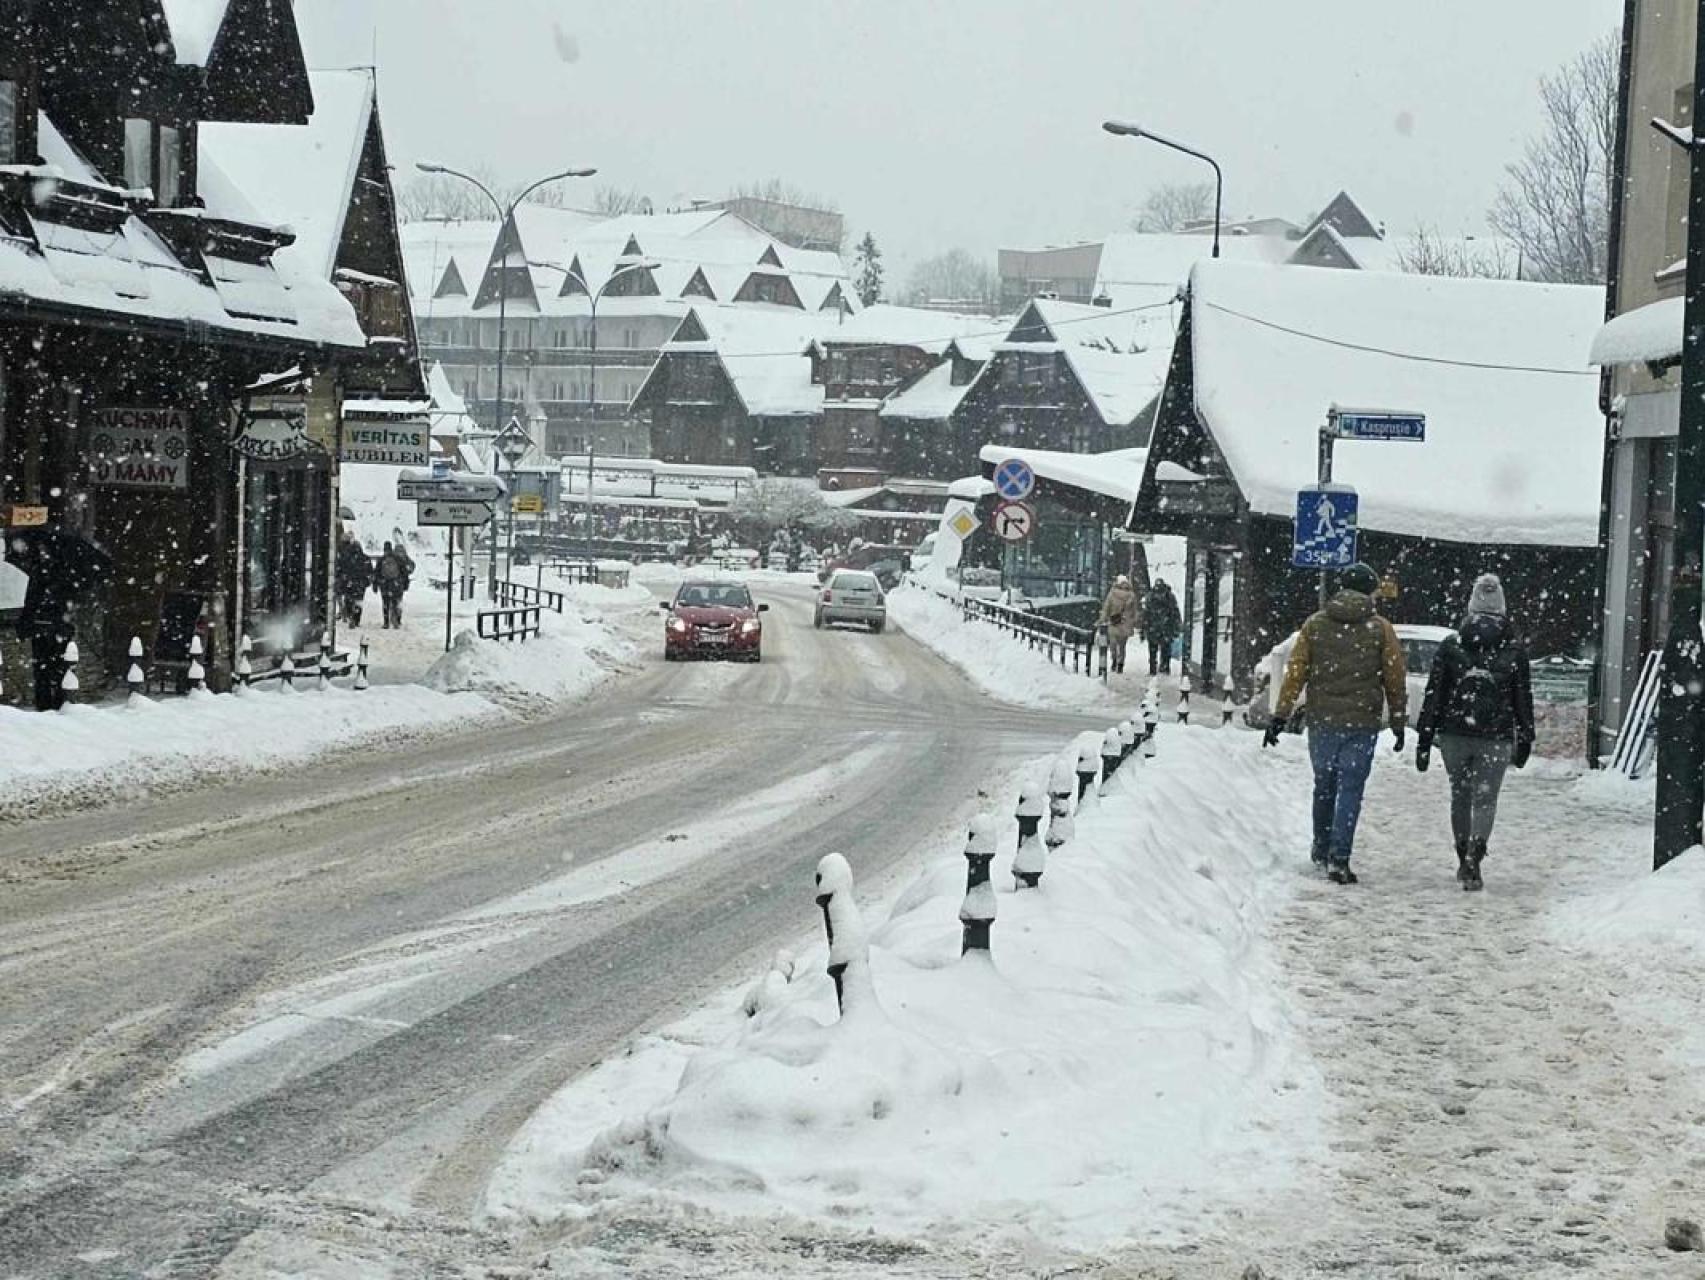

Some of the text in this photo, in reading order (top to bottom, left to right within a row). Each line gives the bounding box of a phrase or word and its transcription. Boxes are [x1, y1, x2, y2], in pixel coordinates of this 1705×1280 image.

[96, 410, 182, 429] KUCHNIA
[1360, 420, 1410, 433] Kasprusie
[344, 449, 425, 463] JUBILER
[115, 463, 177, 483] MAMY
